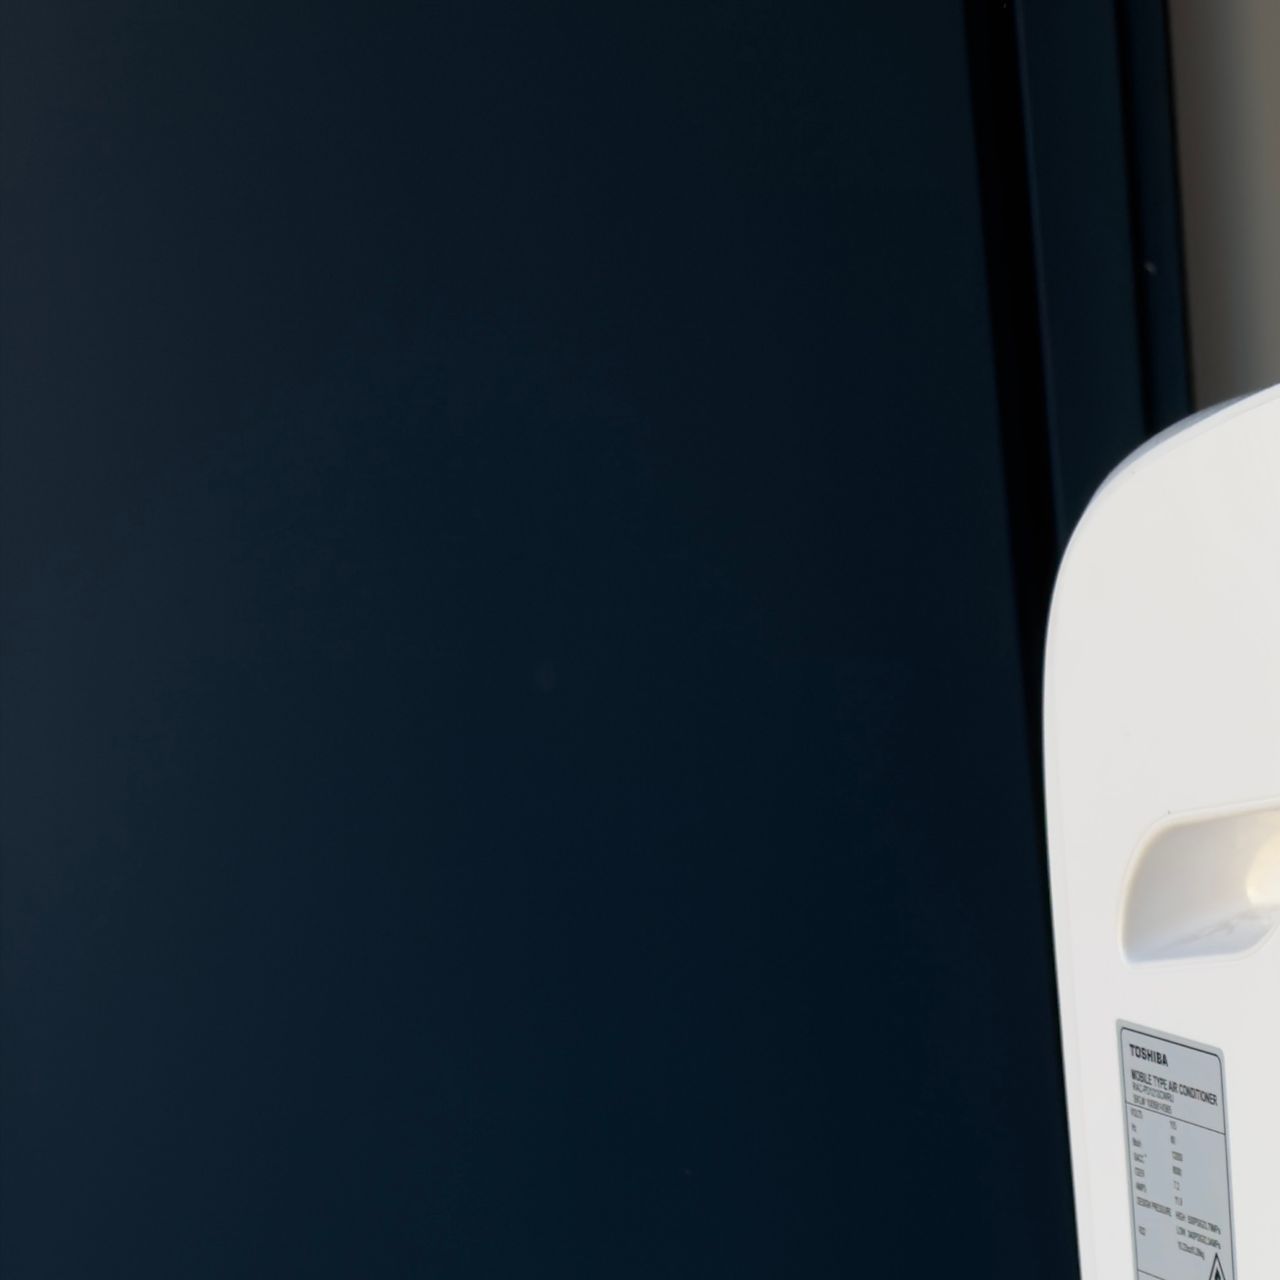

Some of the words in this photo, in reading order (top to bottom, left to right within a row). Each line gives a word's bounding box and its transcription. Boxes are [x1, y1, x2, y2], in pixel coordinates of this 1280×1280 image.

[1129, 1043, 1168, 1066] TOSHIBA
[1131, 1068, 1151, 1085] MOBILE
[1152, 1075, 1167, 1089] TYPE
[1168, 1080, 1177, 1092] AIR
[1178, 1083, 1217, 1106] CONDITIONER
